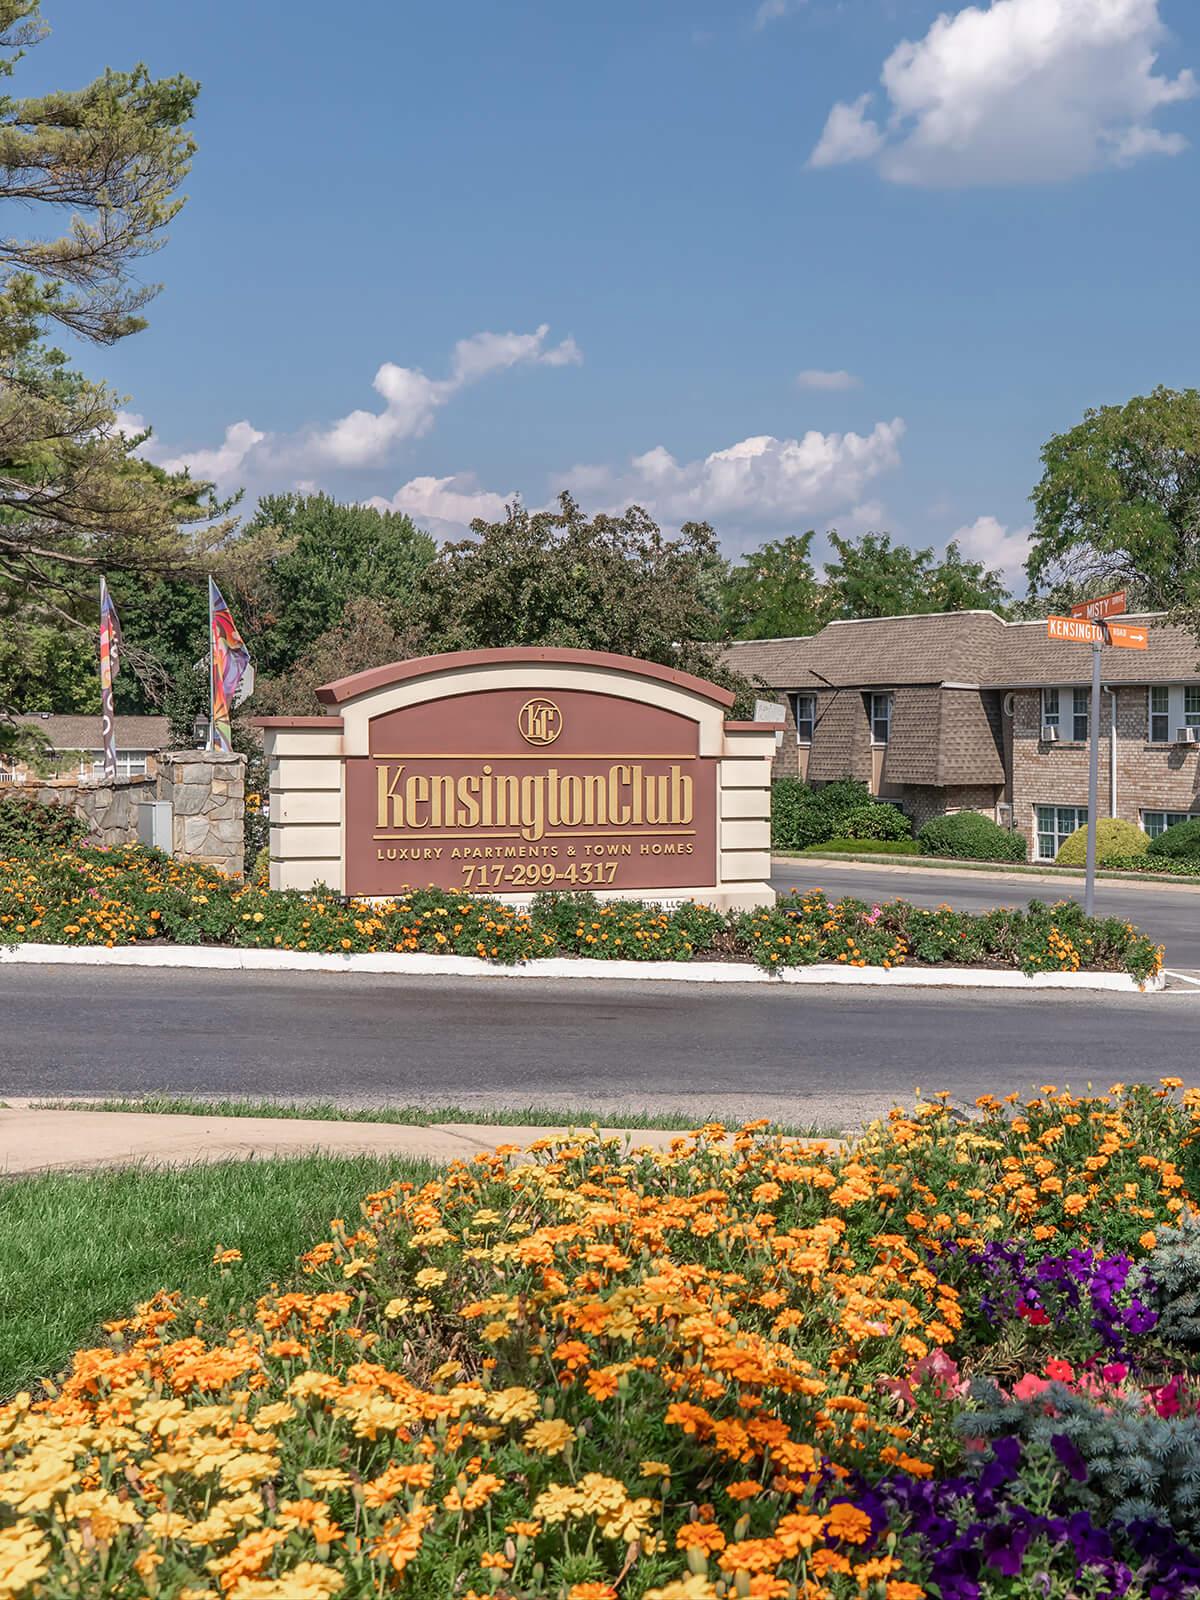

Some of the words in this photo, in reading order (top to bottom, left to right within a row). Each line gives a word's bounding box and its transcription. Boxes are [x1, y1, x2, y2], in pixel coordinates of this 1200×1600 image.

[1086, 599, 1109, 619] MISTY
[1113, 627, 1127, 637] ROAD
[377, 848, 443, 860] LUXURY
[451, 845, 559, 859] APARTMENTS
[567, 846, 577, 857] &
[584, 844, 632, 857] TOWN
[640, 843, 694, 856] HOMES
[461, 862, 619, 888] 717-299-4317
